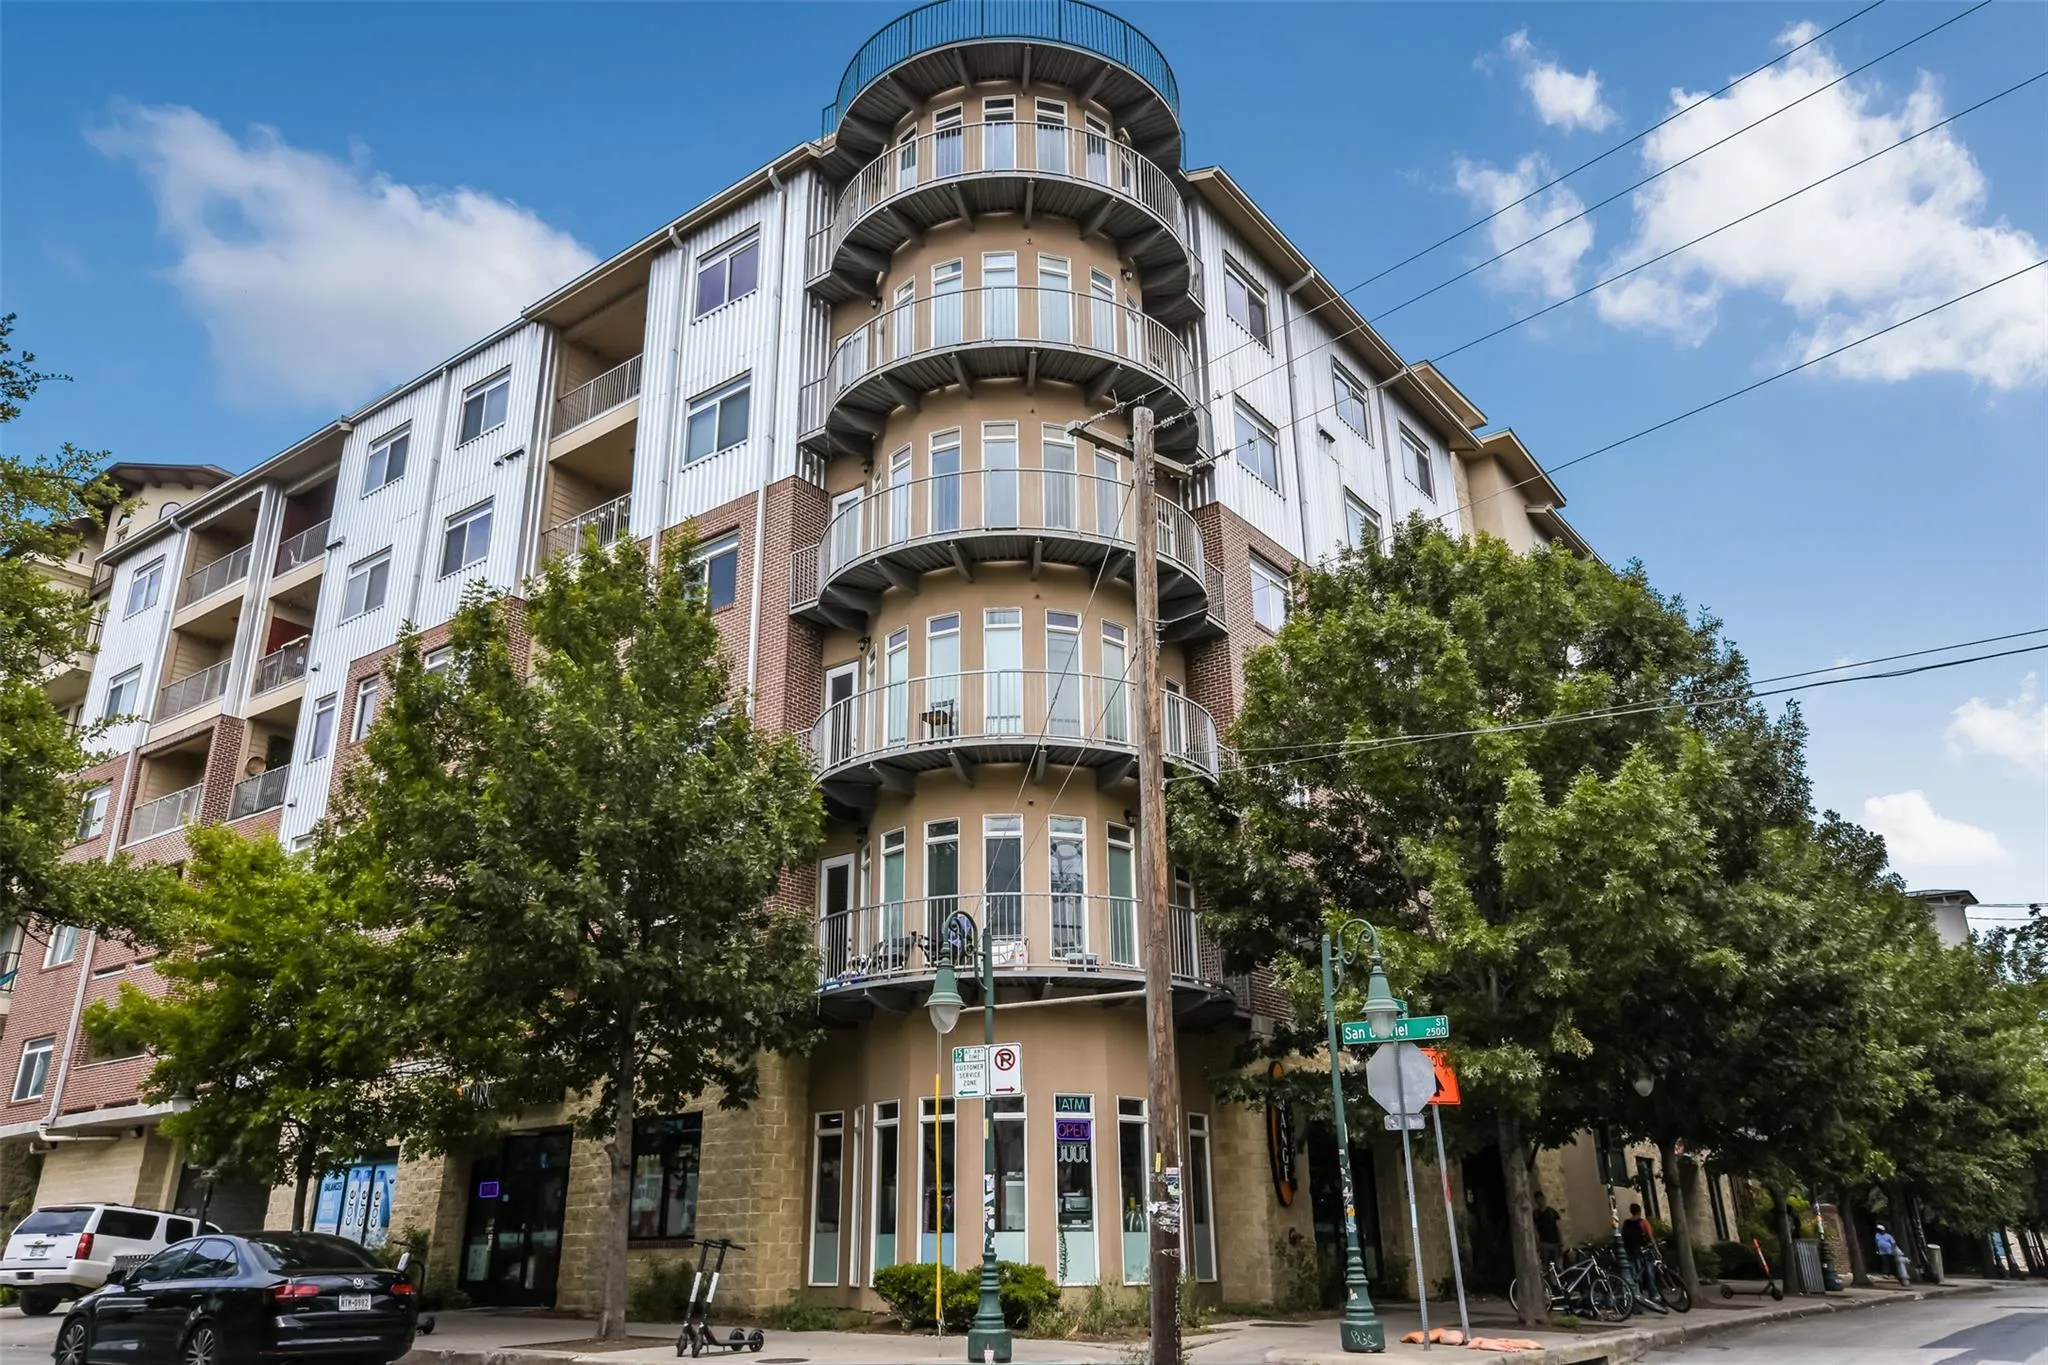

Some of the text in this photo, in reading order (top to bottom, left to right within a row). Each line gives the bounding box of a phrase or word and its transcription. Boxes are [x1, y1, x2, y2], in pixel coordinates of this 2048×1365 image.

[1436, 1018, 1445, 1026] ST
[1345, 1027, 1366, 1040] San
[1425, 1027, 1446, 1037] 2500
[956, 1063, 984, 1071] CUSTOMER
[959, 1071, 981, 1079] SERVICE
[1061, 1097, 1086, 1110] ATM
[1058, 1123, 1088, 1137] OPEN
